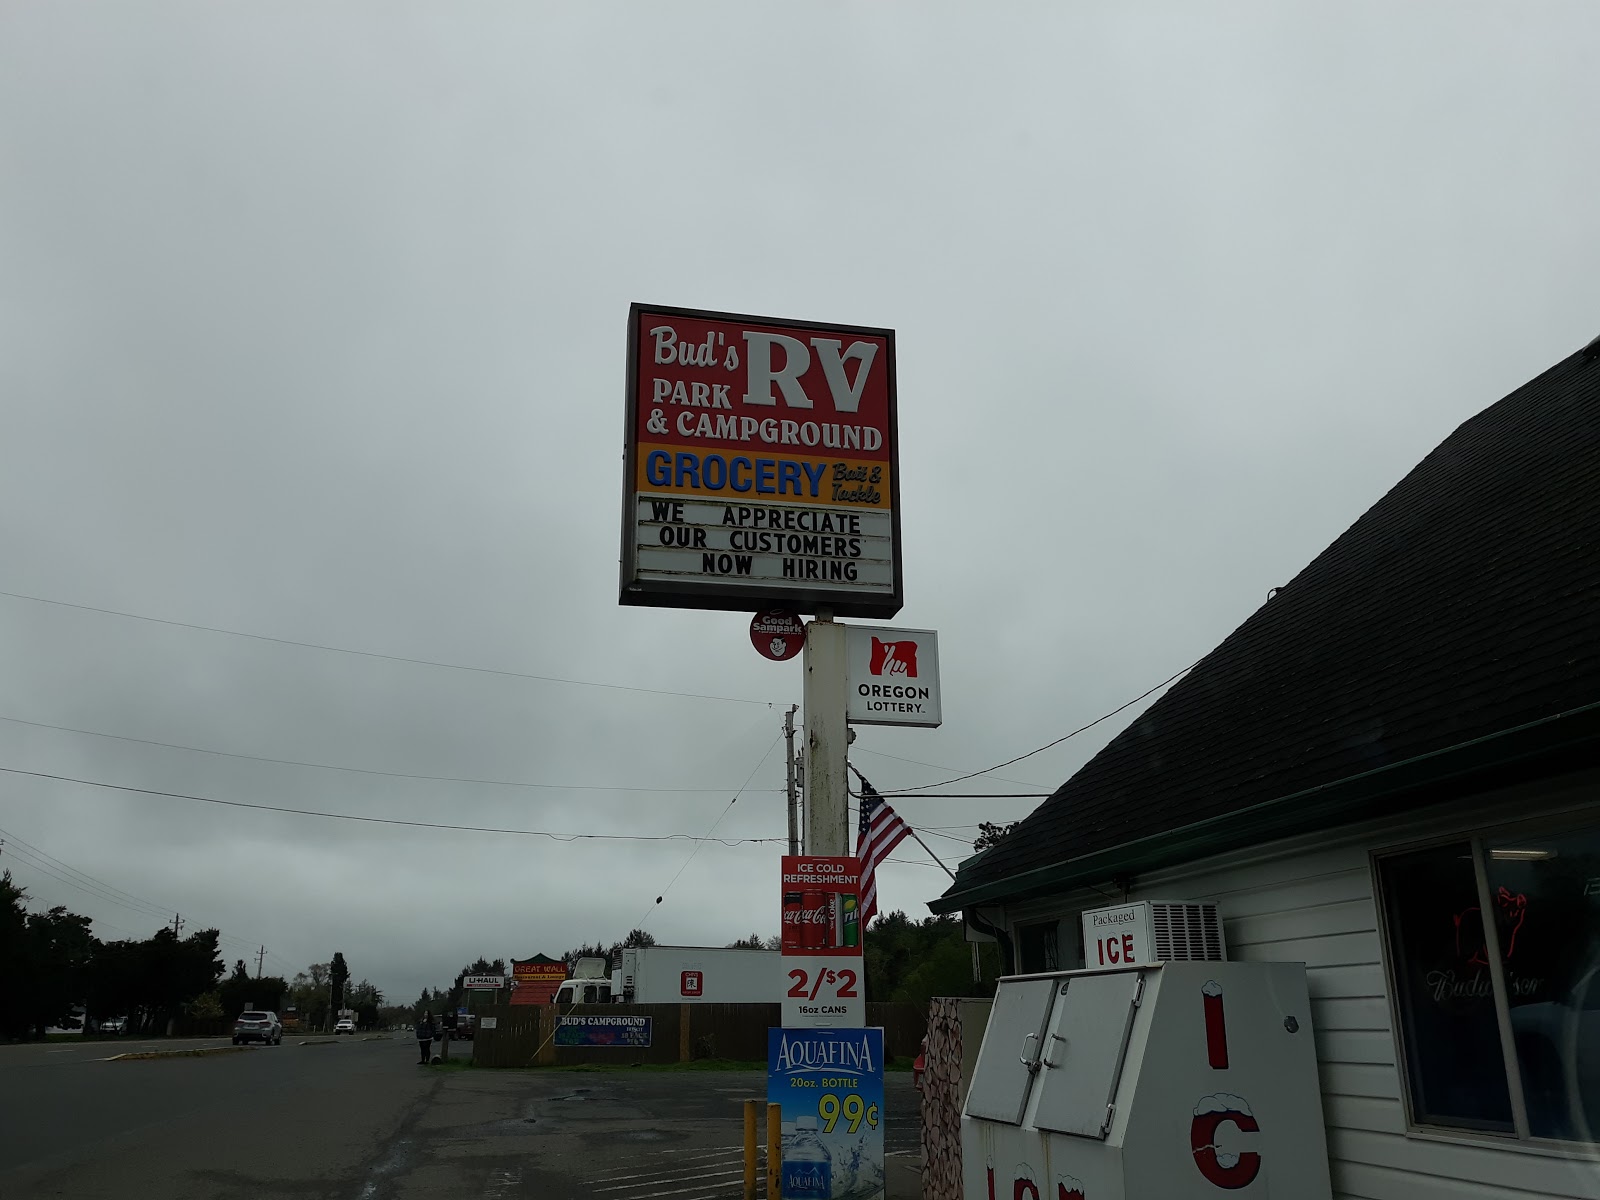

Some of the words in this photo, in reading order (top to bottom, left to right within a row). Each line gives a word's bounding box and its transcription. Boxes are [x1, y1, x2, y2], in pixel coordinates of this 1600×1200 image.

[650, 325, 739, 371] Bud's
[743, 330, 879, 413] RV
[652, 378, 732, 410] PARK
[647, 408, 669, 434] &
[676, 411, 882, 451] CAMPGROUND
[647, 450, 826, 497] GROCERY
[832, 462, 867, 482] Bait
[869, 465, 881, 483] &
[832, 483, 880, 504] Tackle
[652, 501, 684, 522] WE
[723, 506, 860, 534] APPRECIATE
[659, 526, 706, 547] OUR
[730, 530, 861, 557] CUSTOMERS
[703, 553, 752, 575] NOW
[783, 557, 858, 581] HIRING
[753, 623, 802, 633] Sampark
[762, 616, 792, 625] Good
[858, 683, 929, 700] OREGON
[867, 701, 922, 713] LOTTERY
[797, 863, 814, 873] ICE
[816, 864, 845, 873] COLD
[783, 874, 858, 885] REFRESHMENT
[1092, 909, 1136, 927] Packaged
[1097, 932, 1136, 966] ICE
[787, 967, 858, 1001] 2/$2
[798, 1006, 819, 1014] 16oz
[821, 1006, 847, 1014] CANS
[561, 1017, 586, 1026] BUD'S
[588, 1017, 646, 1027] CAMPGROUND
[775, 1033, 876, 1073] AQUAFINA
[790, 1078, 818, 1088] 20oz.
[822, 1078, 858, 1088] BOTTLE
[818, 1093, 879, 1134] 99¢
[788, 1173, 825, 1190] AQUAFINA
